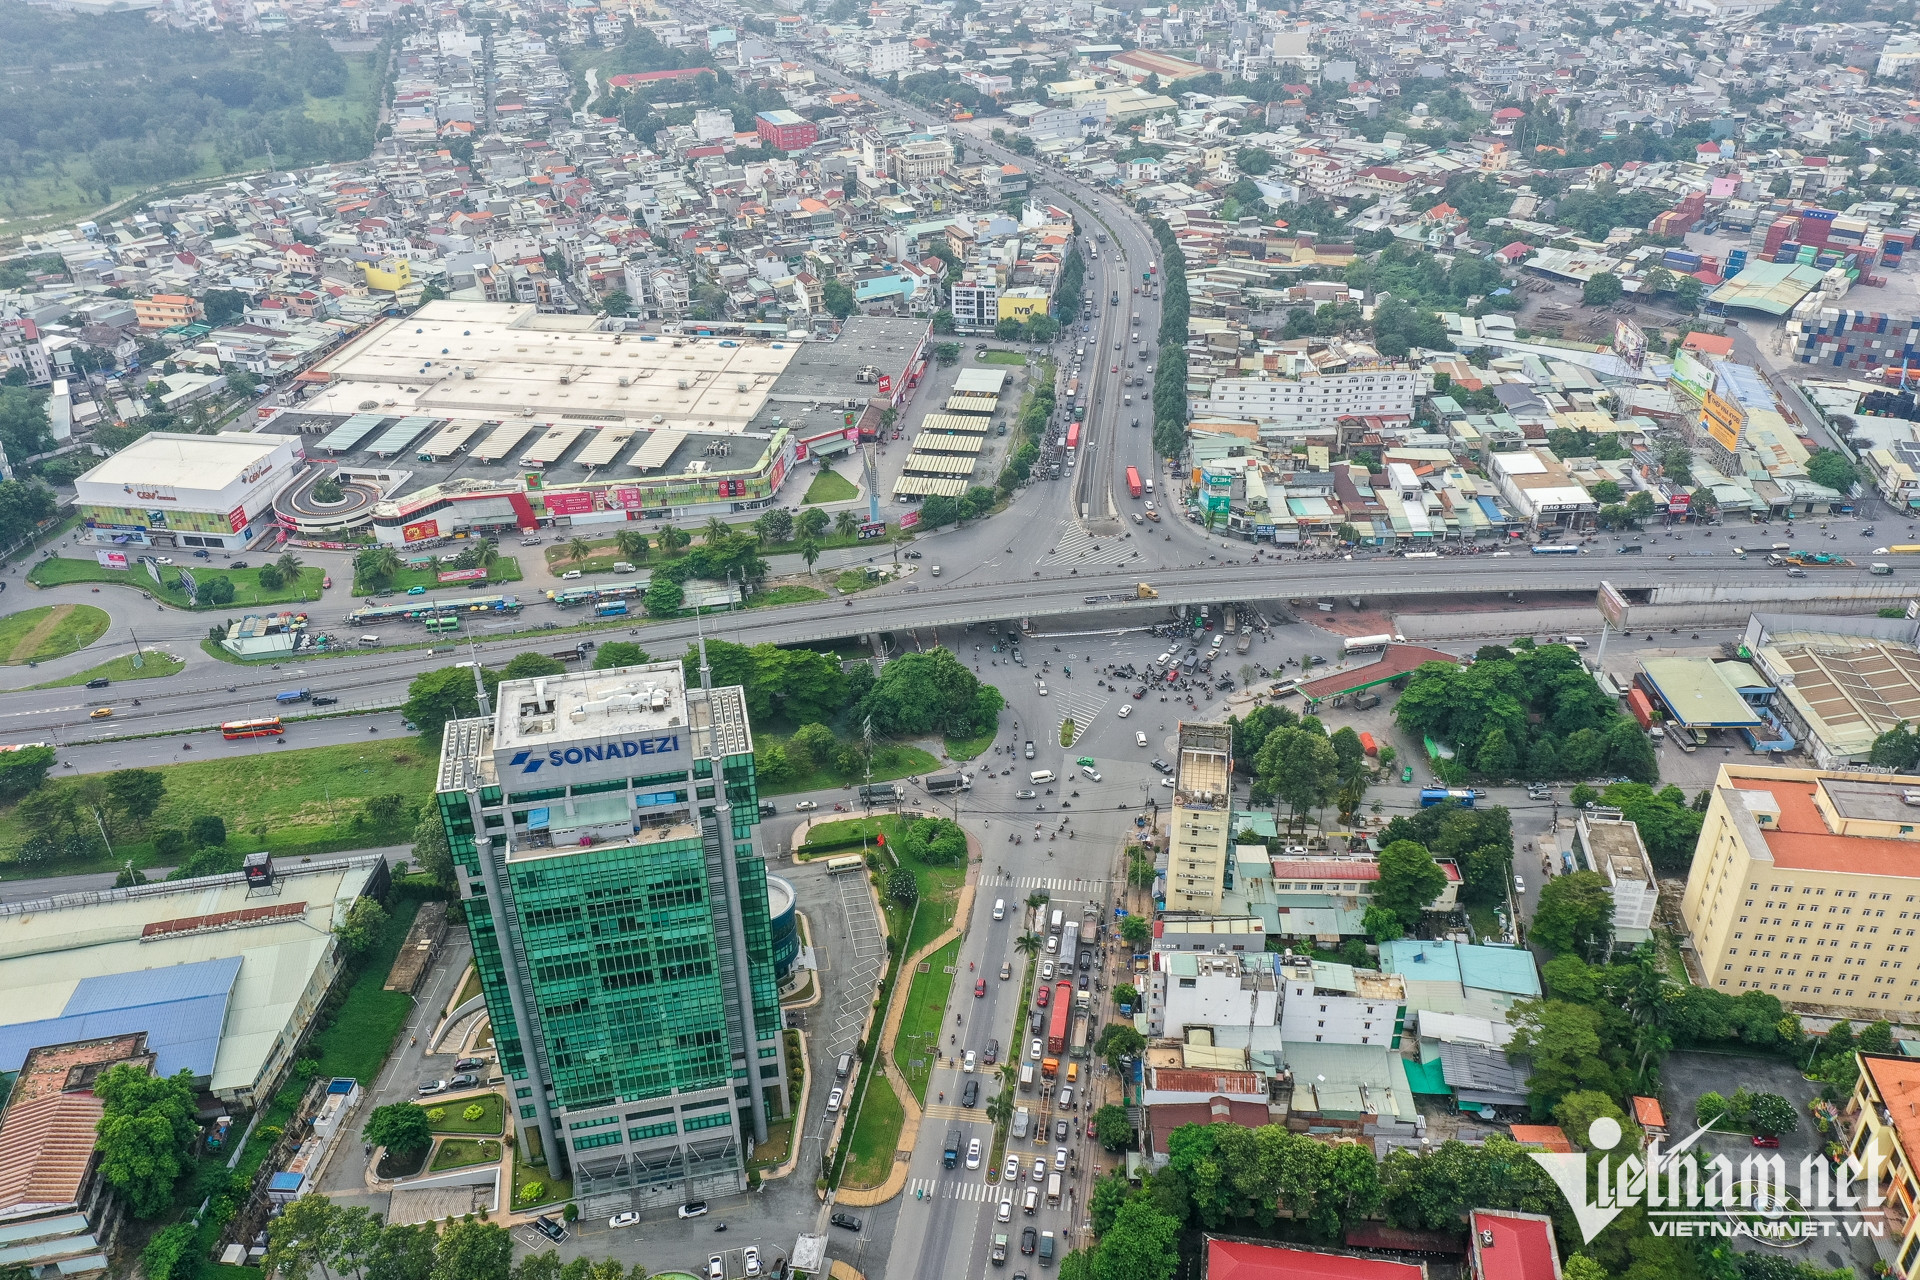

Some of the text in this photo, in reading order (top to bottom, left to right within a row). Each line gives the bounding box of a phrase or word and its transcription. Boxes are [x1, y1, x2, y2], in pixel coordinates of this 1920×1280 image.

[1014, 306, 1030, 315] IVB
[249, 470, 261, 484] CGV
[137, 490, 156, 500] CGV
[549, 735, 679, 767] SONADEZI
